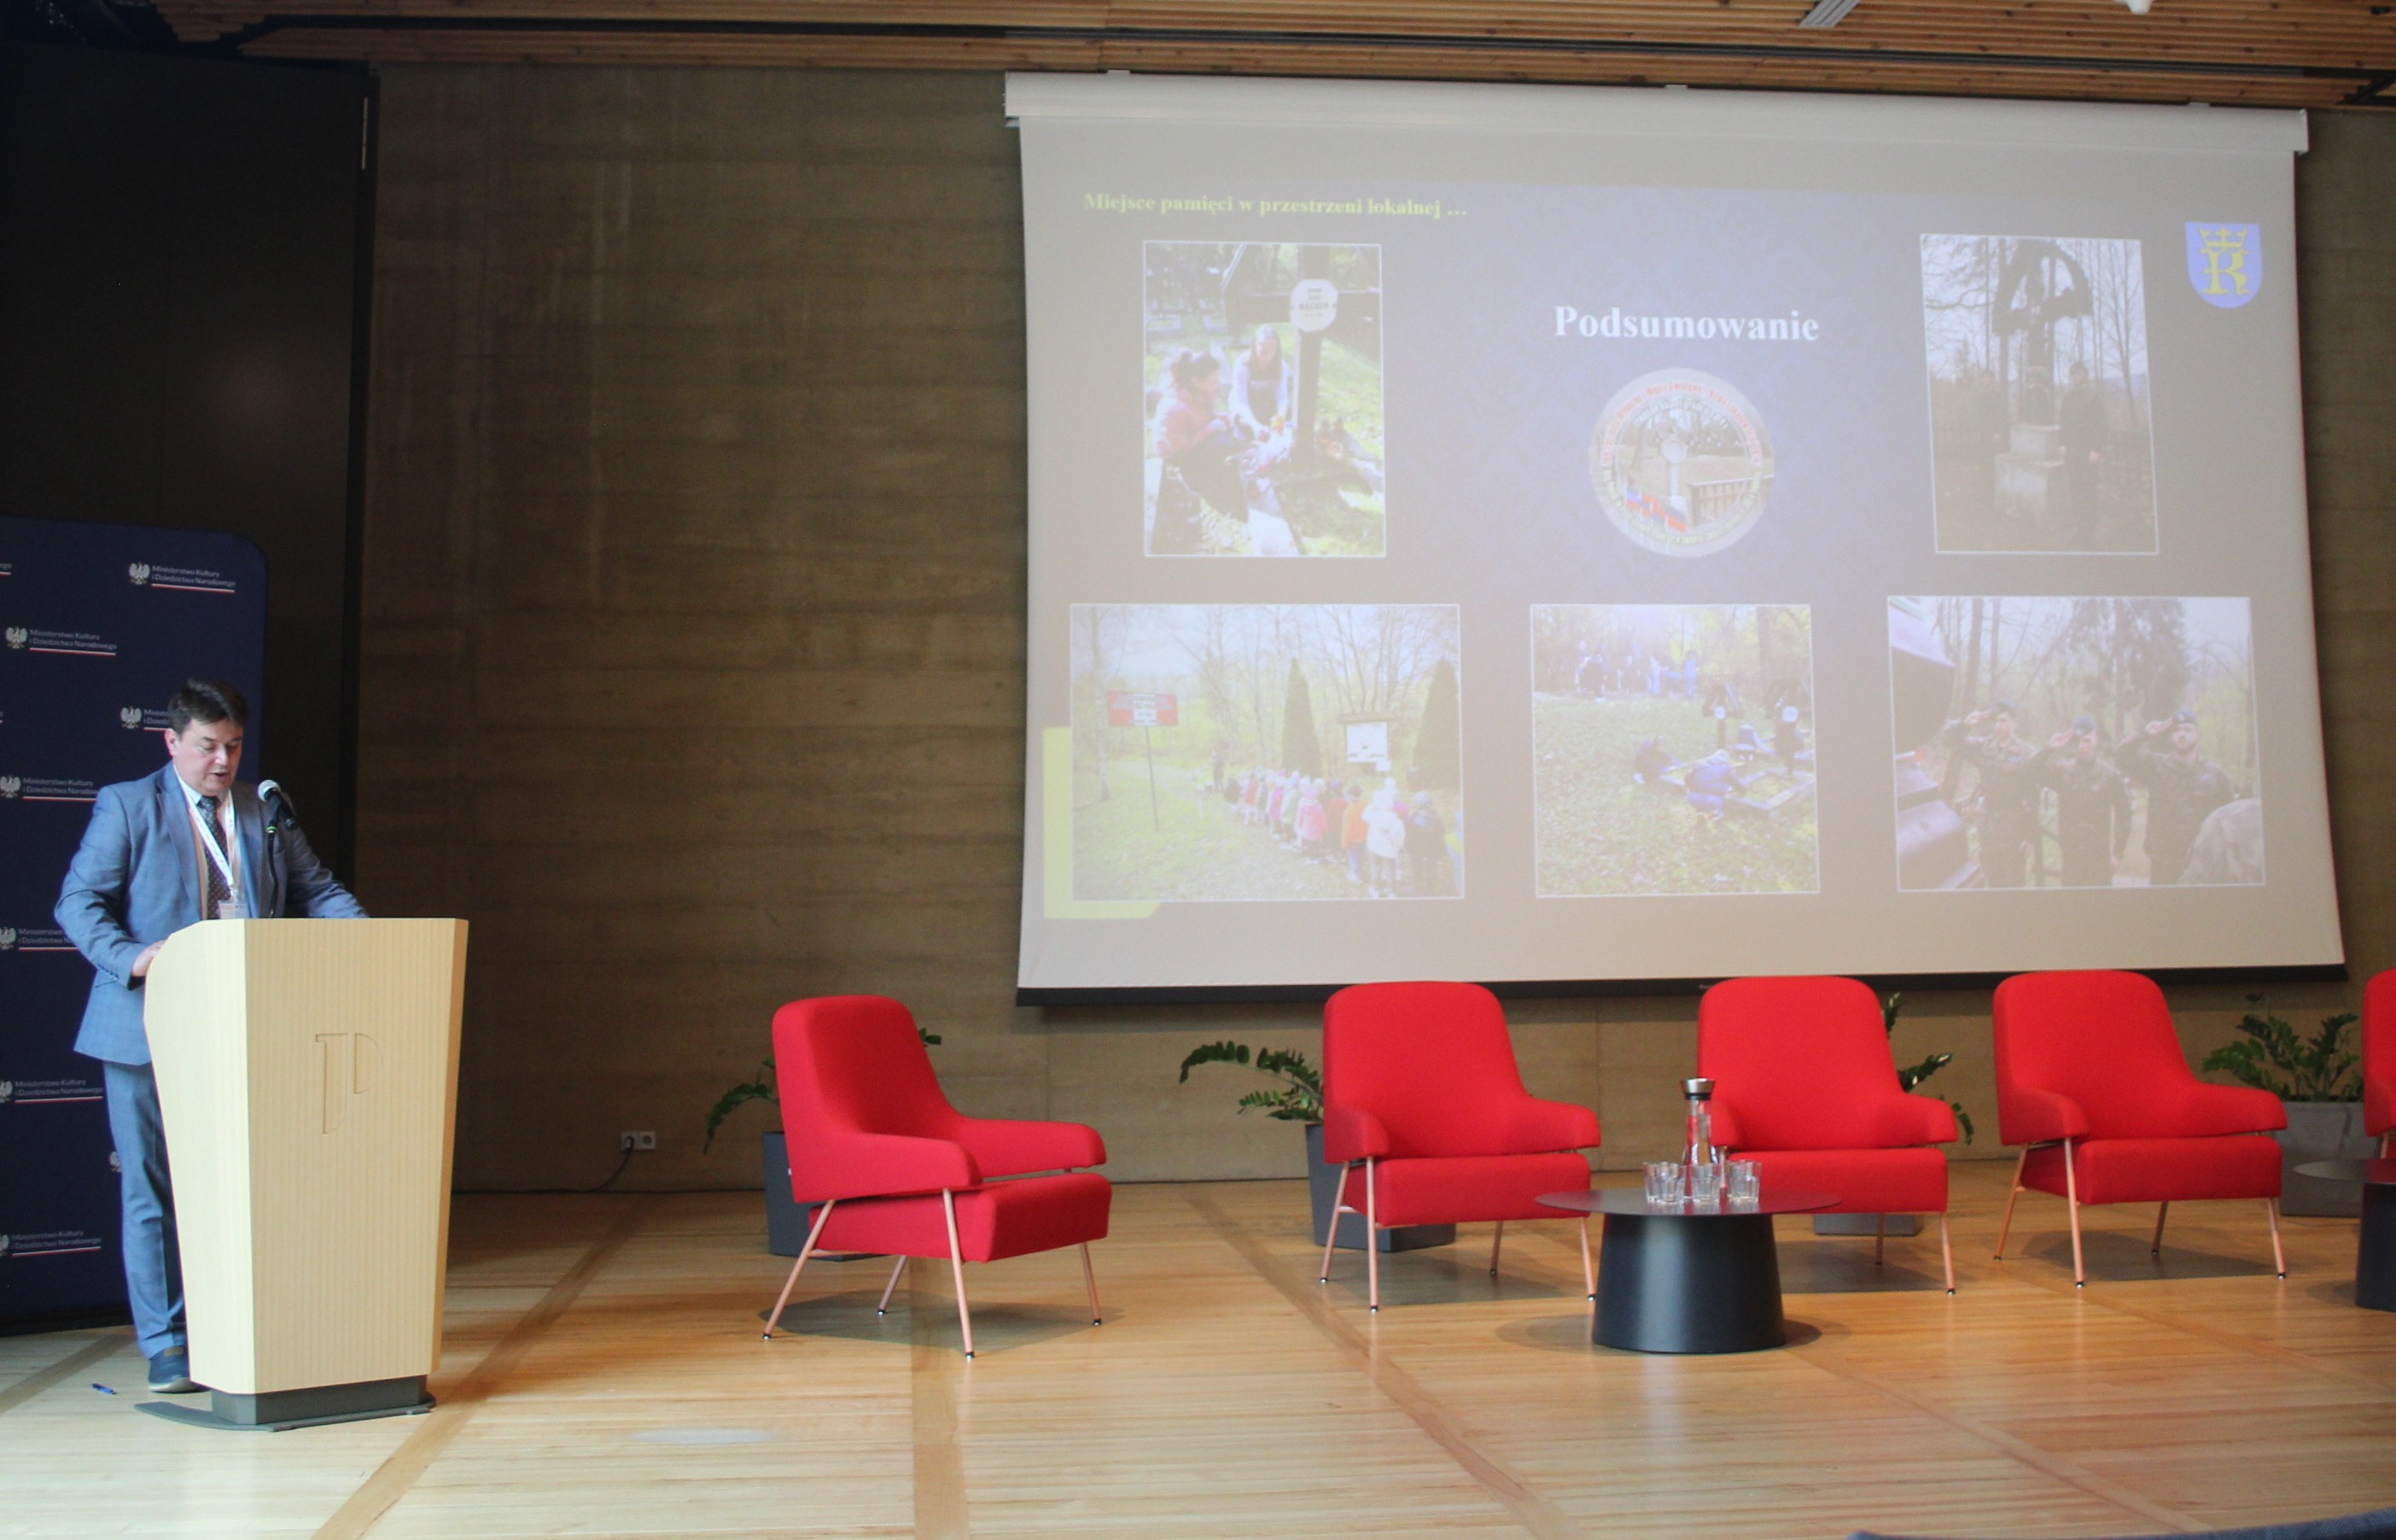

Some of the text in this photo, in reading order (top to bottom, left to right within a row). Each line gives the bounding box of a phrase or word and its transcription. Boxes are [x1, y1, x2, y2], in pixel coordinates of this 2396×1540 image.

[1084, 193, 1156, 213] Miejsce
[1161, 195, 1233, 215] pamięci
[1239, 199, 1253, 211] w
[1259, 198, 1362, 217] przestrzeni
[1367, 198, 1442, 220] lokalnej
[1554, 306, 1819, 341] Podsumowanie
[152, 565, 220, 579] Ministerstwo Kultury
[155, 575, 195, 583] Dziedzictwa
[195, 578, 236, 587] Narodowego
[30, 629, 101, 641] Ministerstwo Kultury
[32, 638, 74, 646] Dziedzictwa
[74, 640, 117, 650] Narodowego
